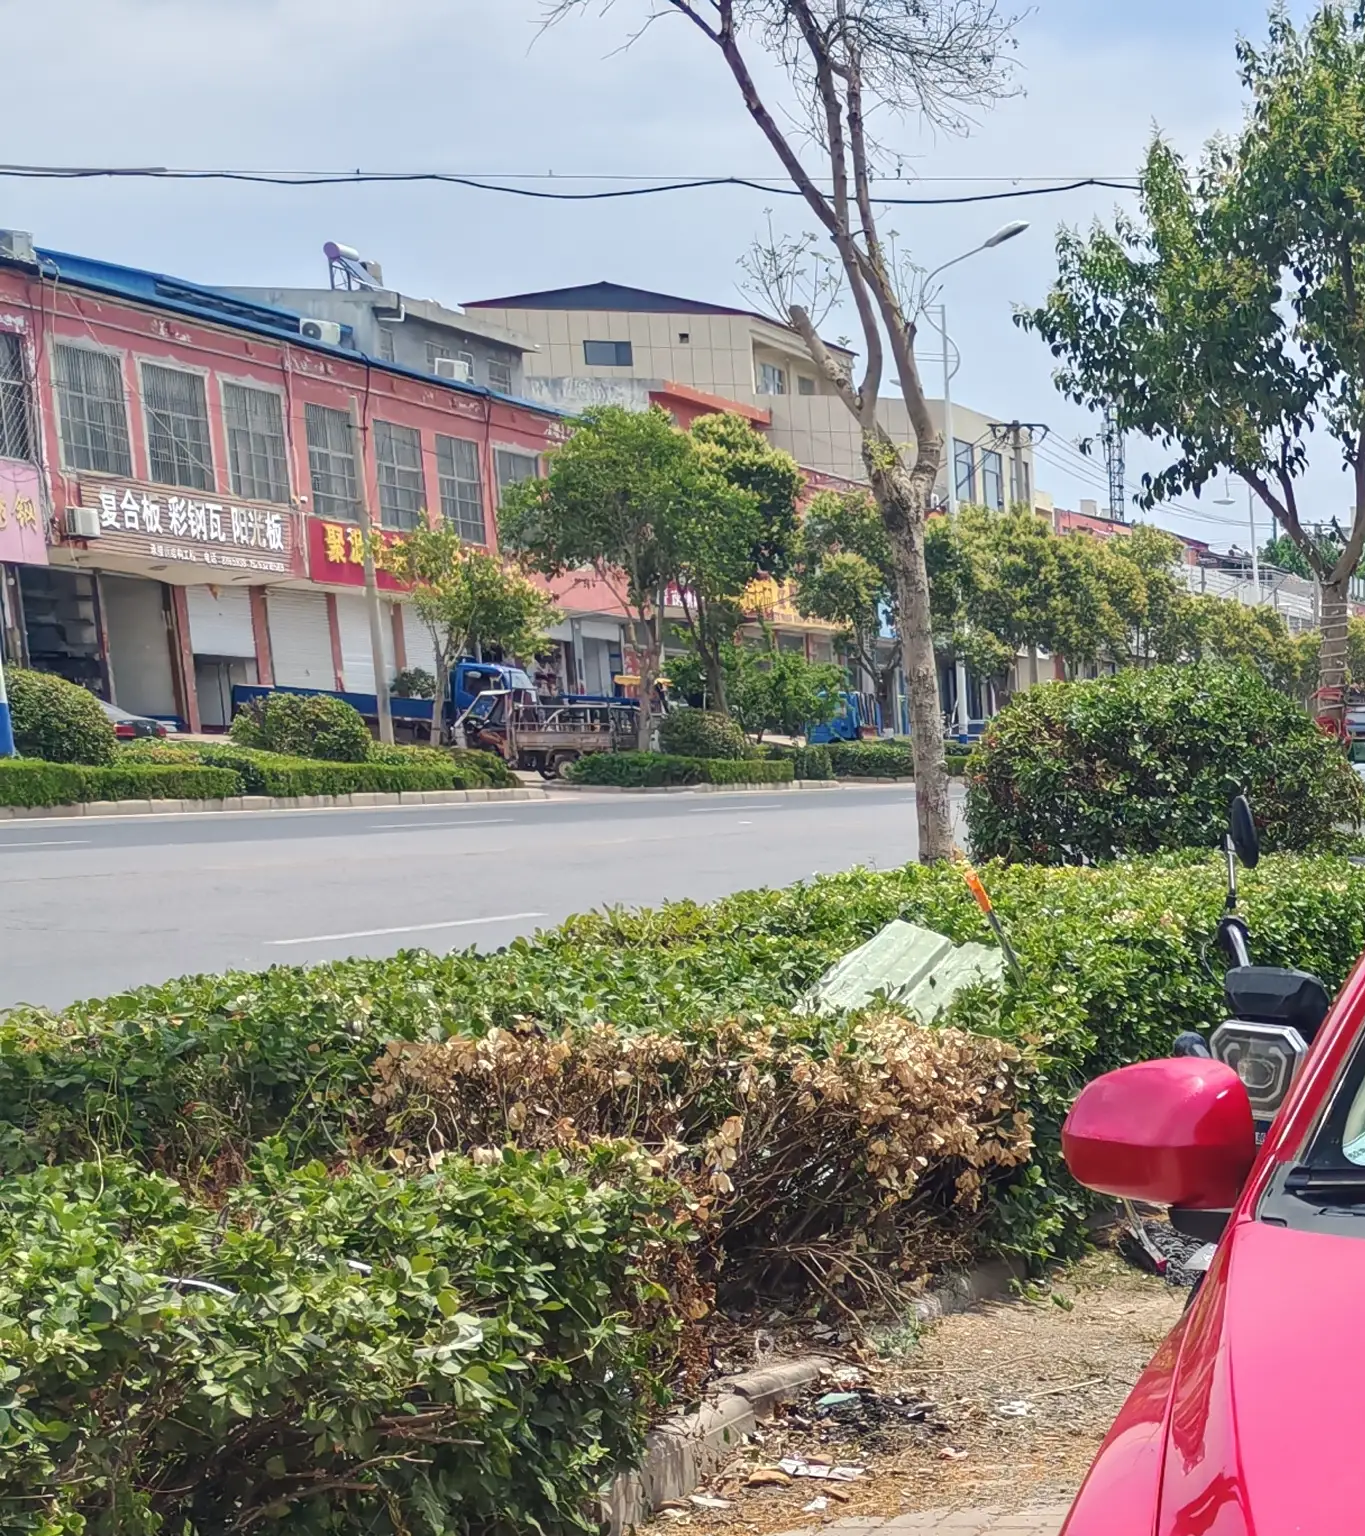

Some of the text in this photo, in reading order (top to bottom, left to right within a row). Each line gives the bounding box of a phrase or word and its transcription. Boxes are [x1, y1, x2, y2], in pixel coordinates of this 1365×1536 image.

[99, 486, 163, 535] 复合板
[167, 495, 226, 543] 彩钢瓦
[231, 506, 284, 550] 阳光板
